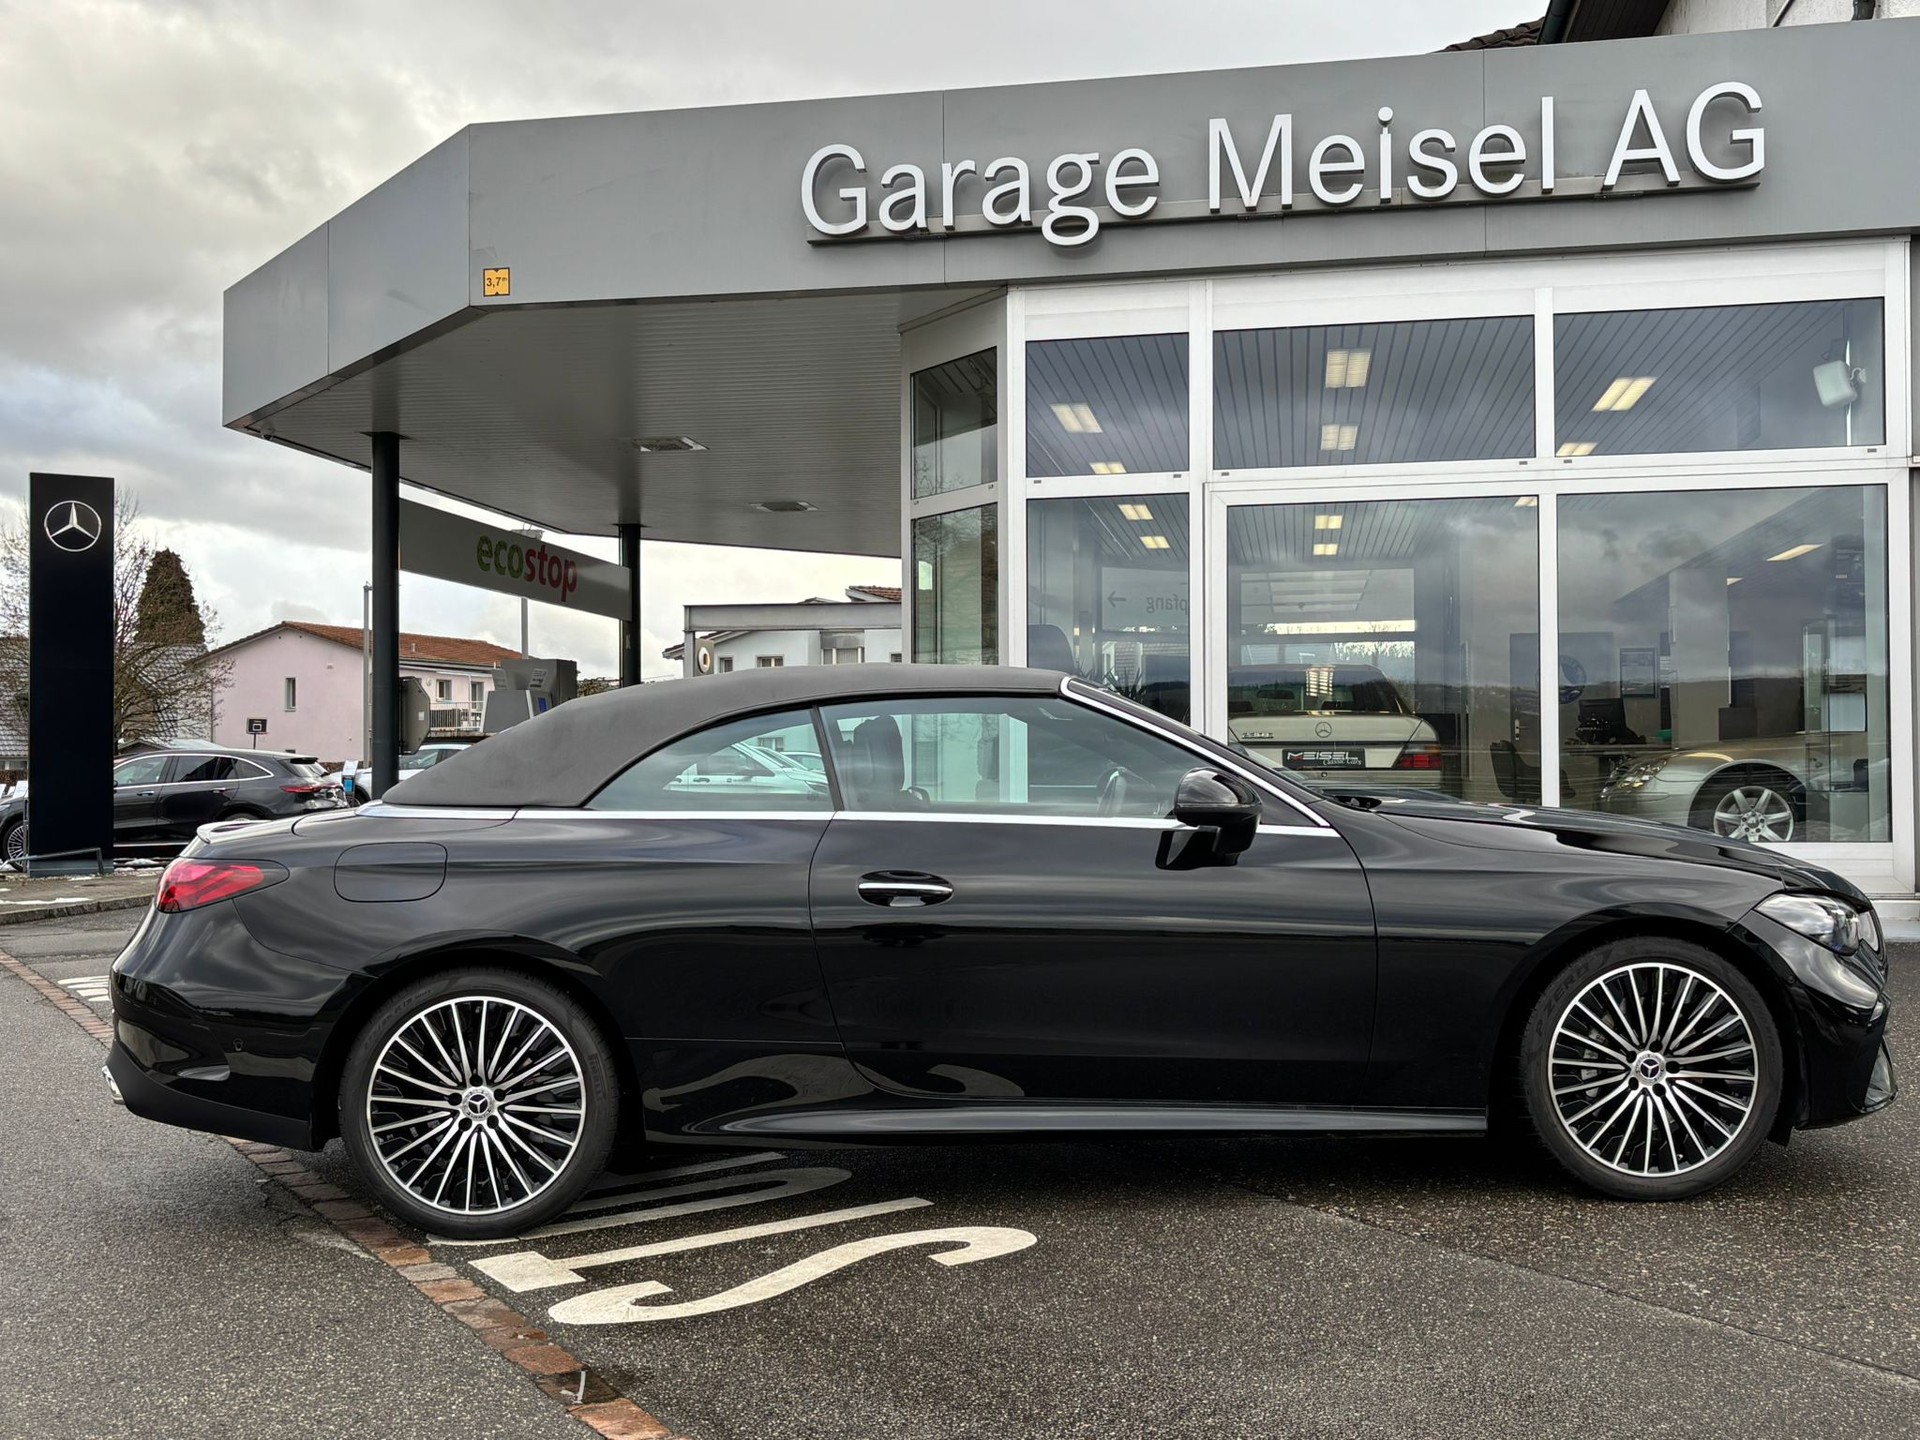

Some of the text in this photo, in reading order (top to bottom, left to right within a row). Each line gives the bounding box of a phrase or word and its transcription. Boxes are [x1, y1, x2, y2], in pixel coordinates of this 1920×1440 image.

[801, 81, 1766, 247] Garage Meisel AG
[476, 535, 578, 603] ecostop
[1287, 751, 1358, 761] MEISEL
